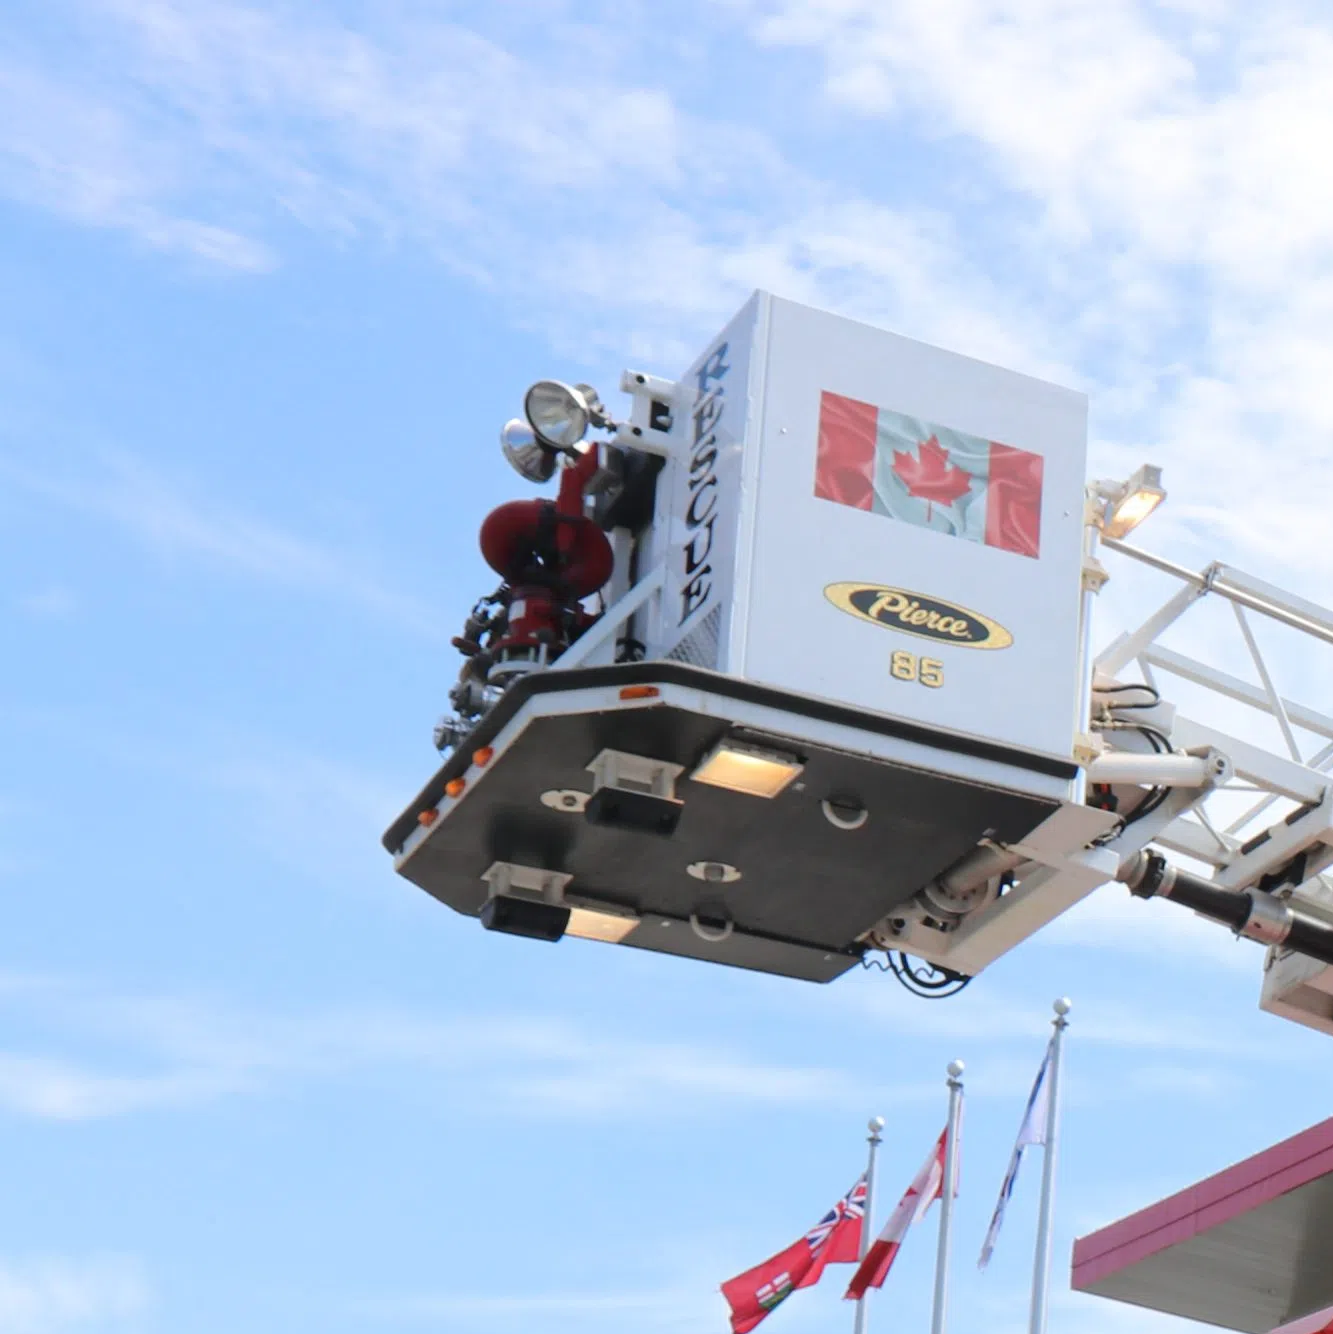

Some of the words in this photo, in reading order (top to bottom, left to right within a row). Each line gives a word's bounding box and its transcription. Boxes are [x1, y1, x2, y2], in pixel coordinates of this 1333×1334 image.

[677, 341, 729, 627] RESCUE
[867, 590, 970, 638] Pierce
[890, 651, 945, 689] 85
